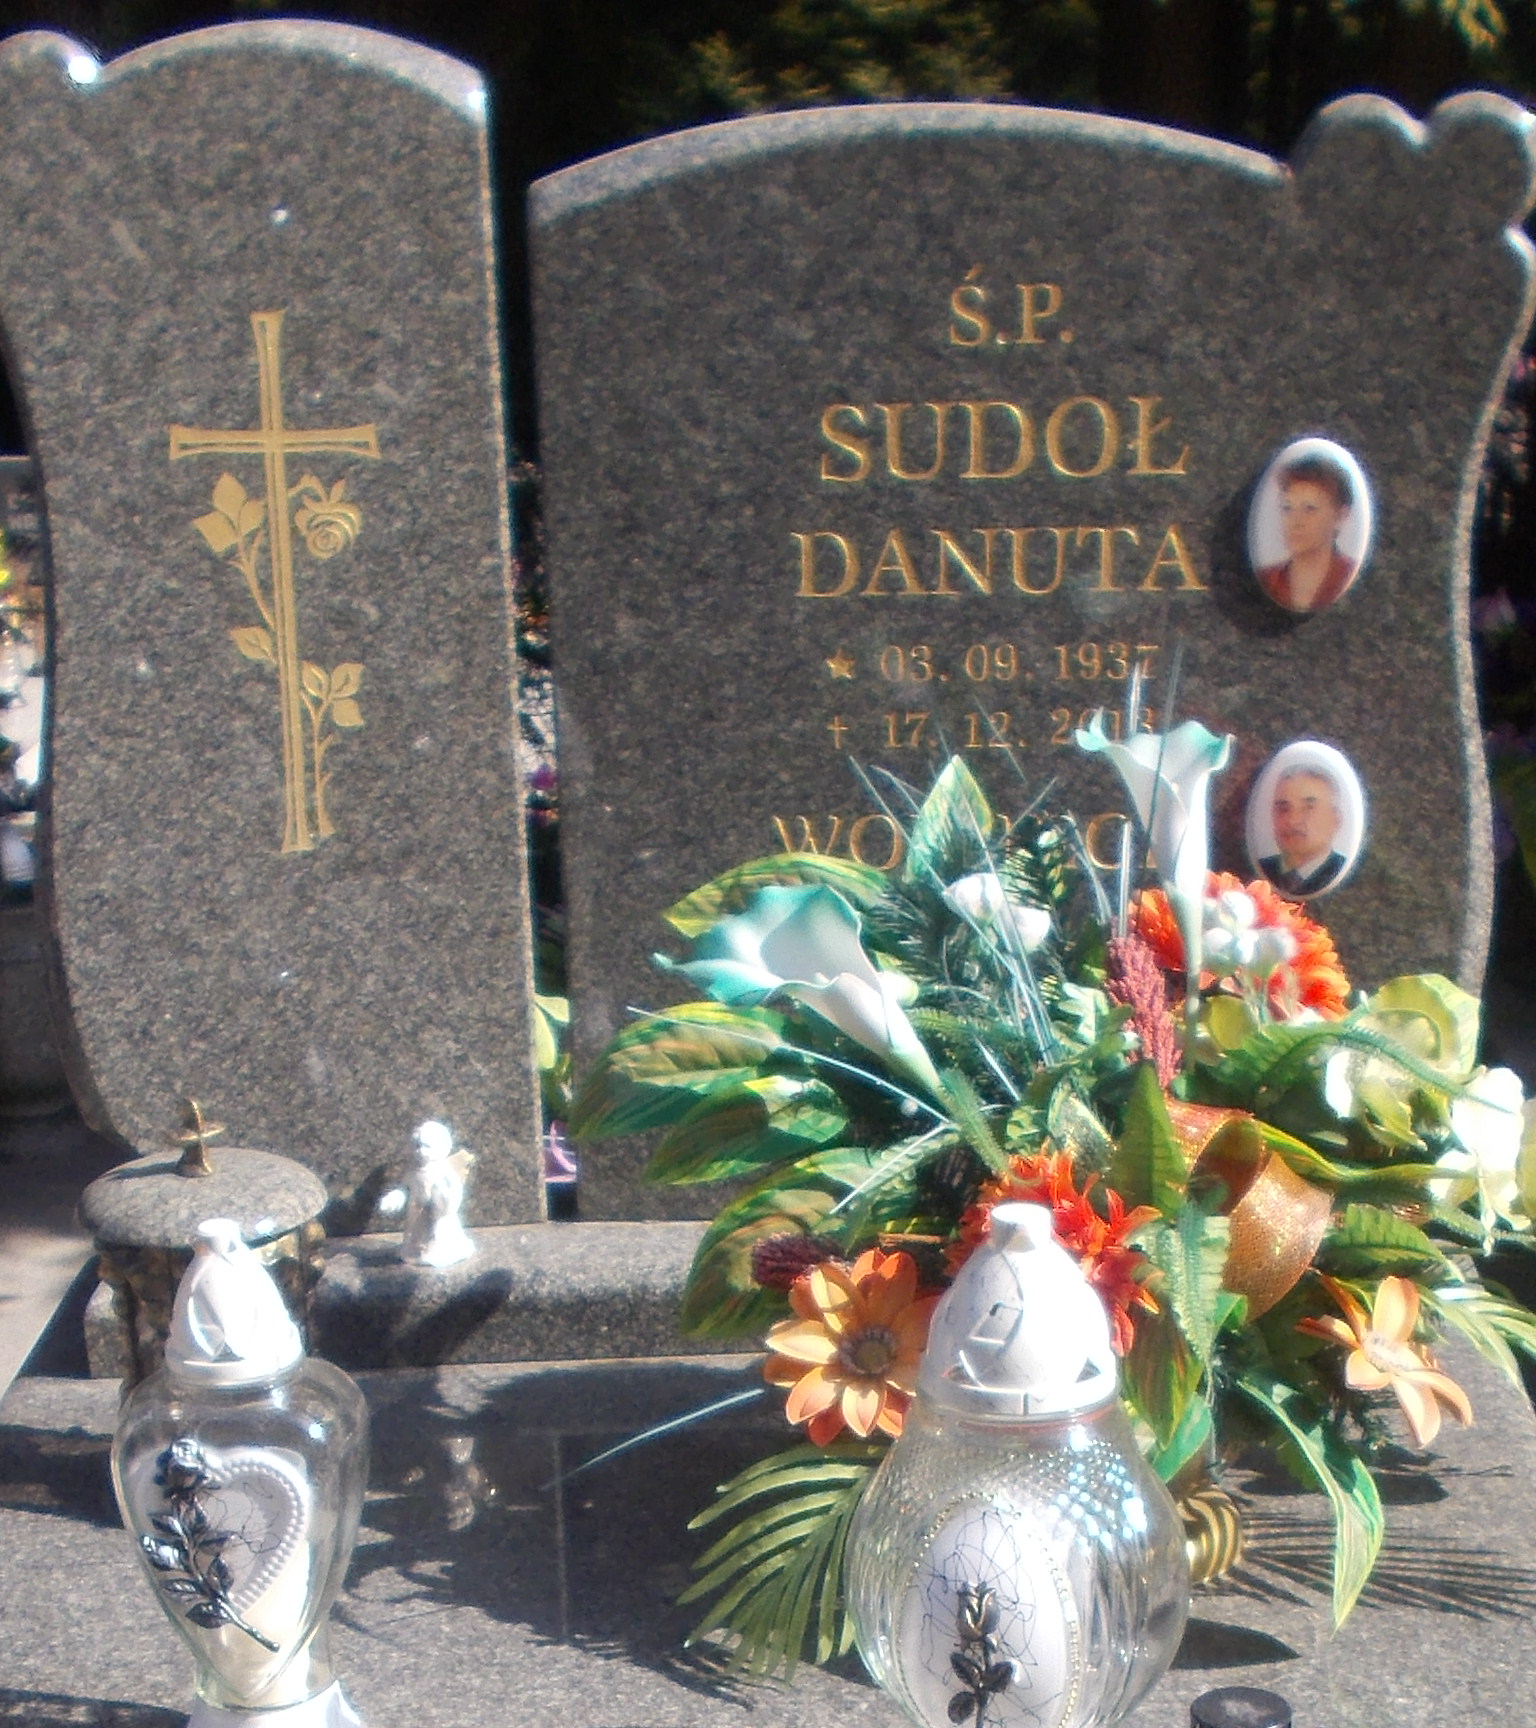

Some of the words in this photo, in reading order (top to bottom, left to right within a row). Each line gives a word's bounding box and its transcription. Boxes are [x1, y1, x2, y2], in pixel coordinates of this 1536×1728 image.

[949, 264, 1075, 347] Ś.P.
[820, 395, 1190, 484] SUDOŁ
[792, 524, 1210, 599] DANUTA
[879, 643, 949, 683] 03.
[965, 642, 1034, 683] 09.
[1053, 641, 1160, 681] 1937
[964, 710, 1027, 749] 12.
